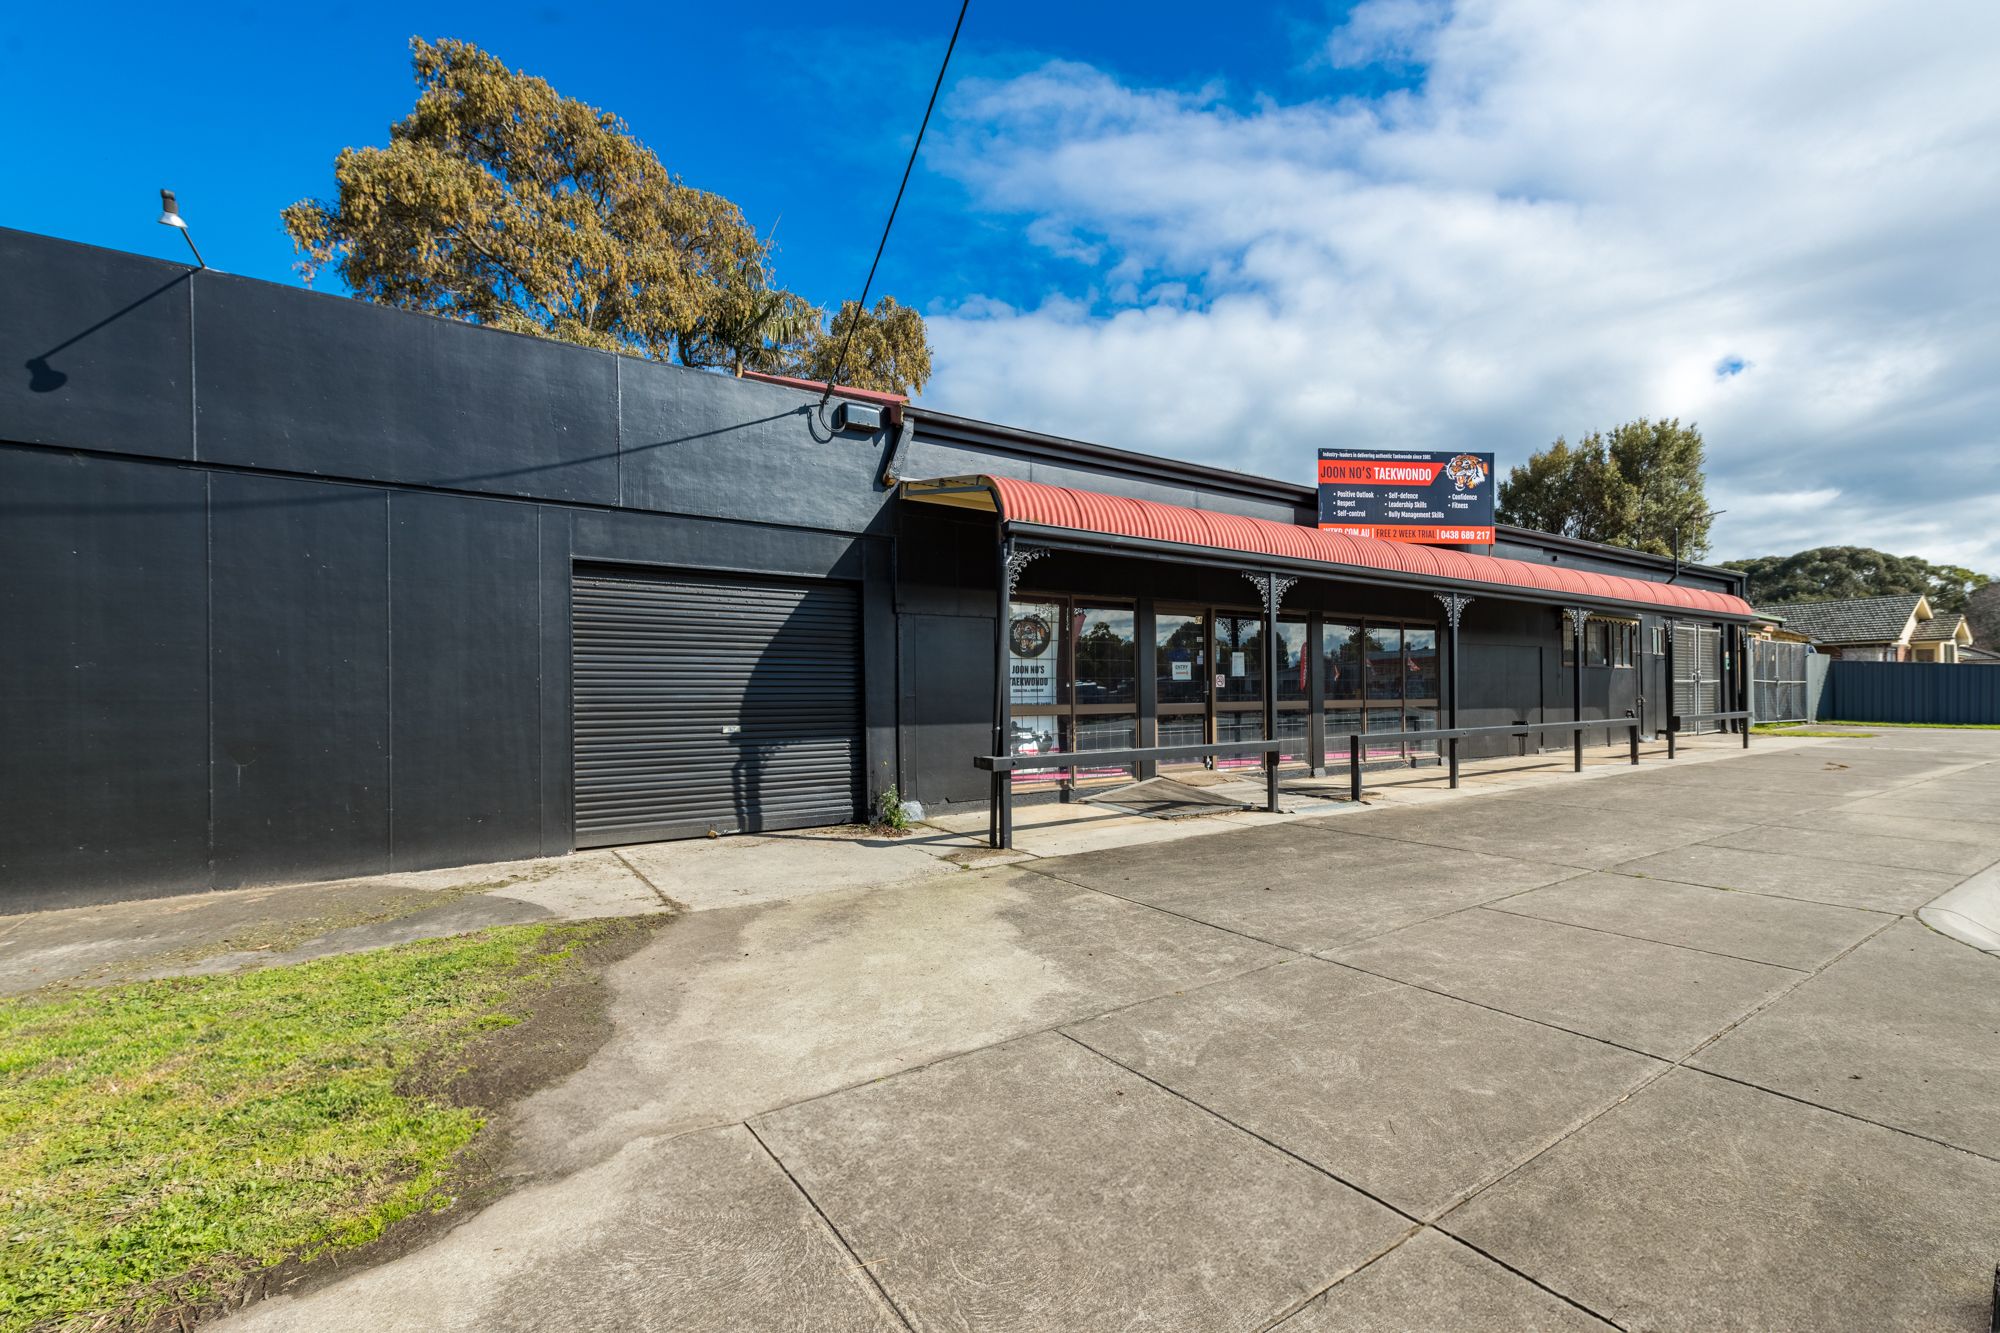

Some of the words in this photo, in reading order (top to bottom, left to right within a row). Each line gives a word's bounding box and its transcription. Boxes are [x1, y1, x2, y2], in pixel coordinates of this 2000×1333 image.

[1321, 466, 1346, 478] JOON
[1349, 467, 1371, 478] NO'S
[1374, 467, 1431, 480] TAEKWONDO
[1388, 501, 1413, 509] Leadership
[1337, 509, 1365, 517] Self-control
[1401, 511, 1430, 519] Management
[1376, 529, 1391, 537] FREE
[1392, 529, 1397, 538] 2
[1399, 529, 1416, 538] WEEK
[1418, 529, 1435, 538] TRIAL
[1440, 530, 1459, 539] 0438
[1476, 531, 1490, 539] 217
[1012, 665, 1029, 674] JOON
[1010, 677, 1048, 686] AEKWONDO
